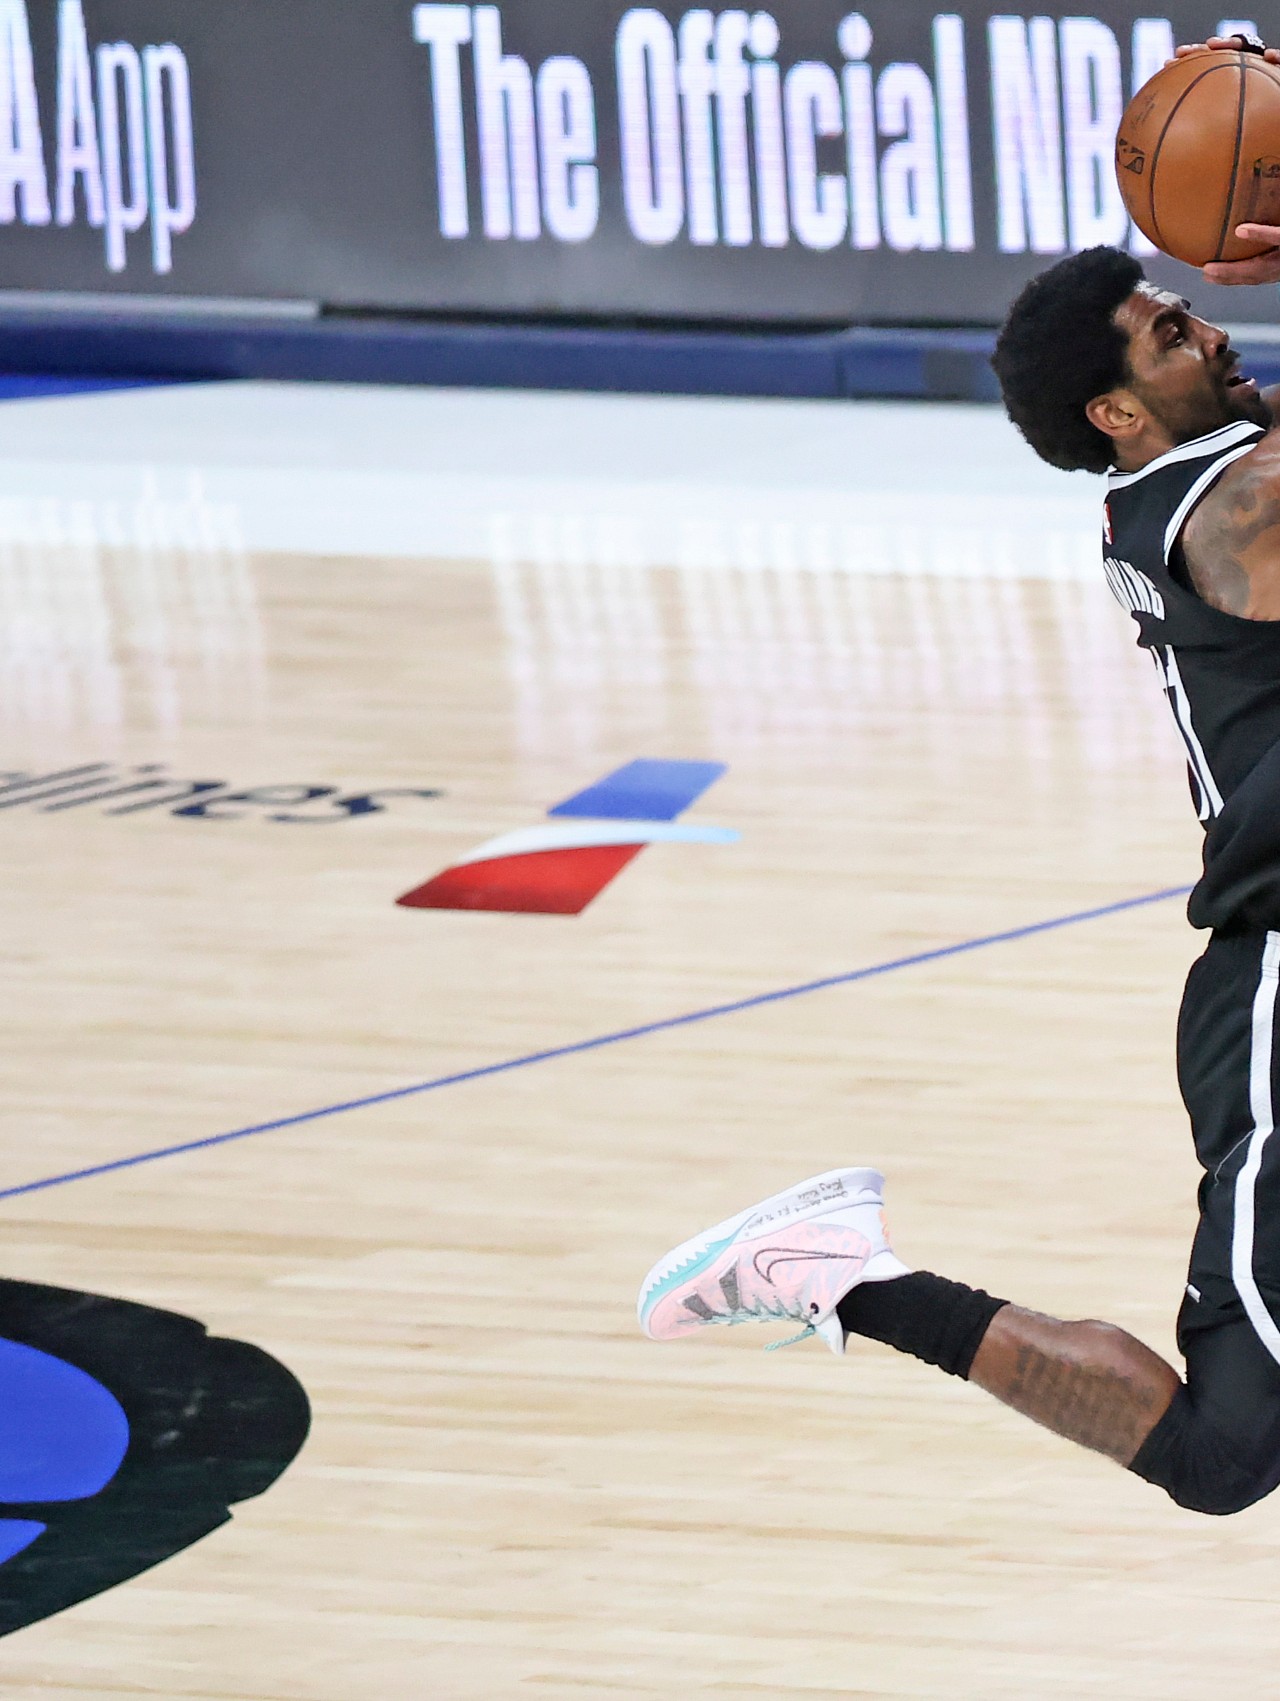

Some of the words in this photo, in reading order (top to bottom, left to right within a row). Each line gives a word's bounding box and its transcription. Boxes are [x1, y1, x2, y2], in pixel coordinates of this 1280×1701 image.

[56, 0, 197, 275] App
[413, 3, 600, 241] The
[614, 8, 976, 254] Official
